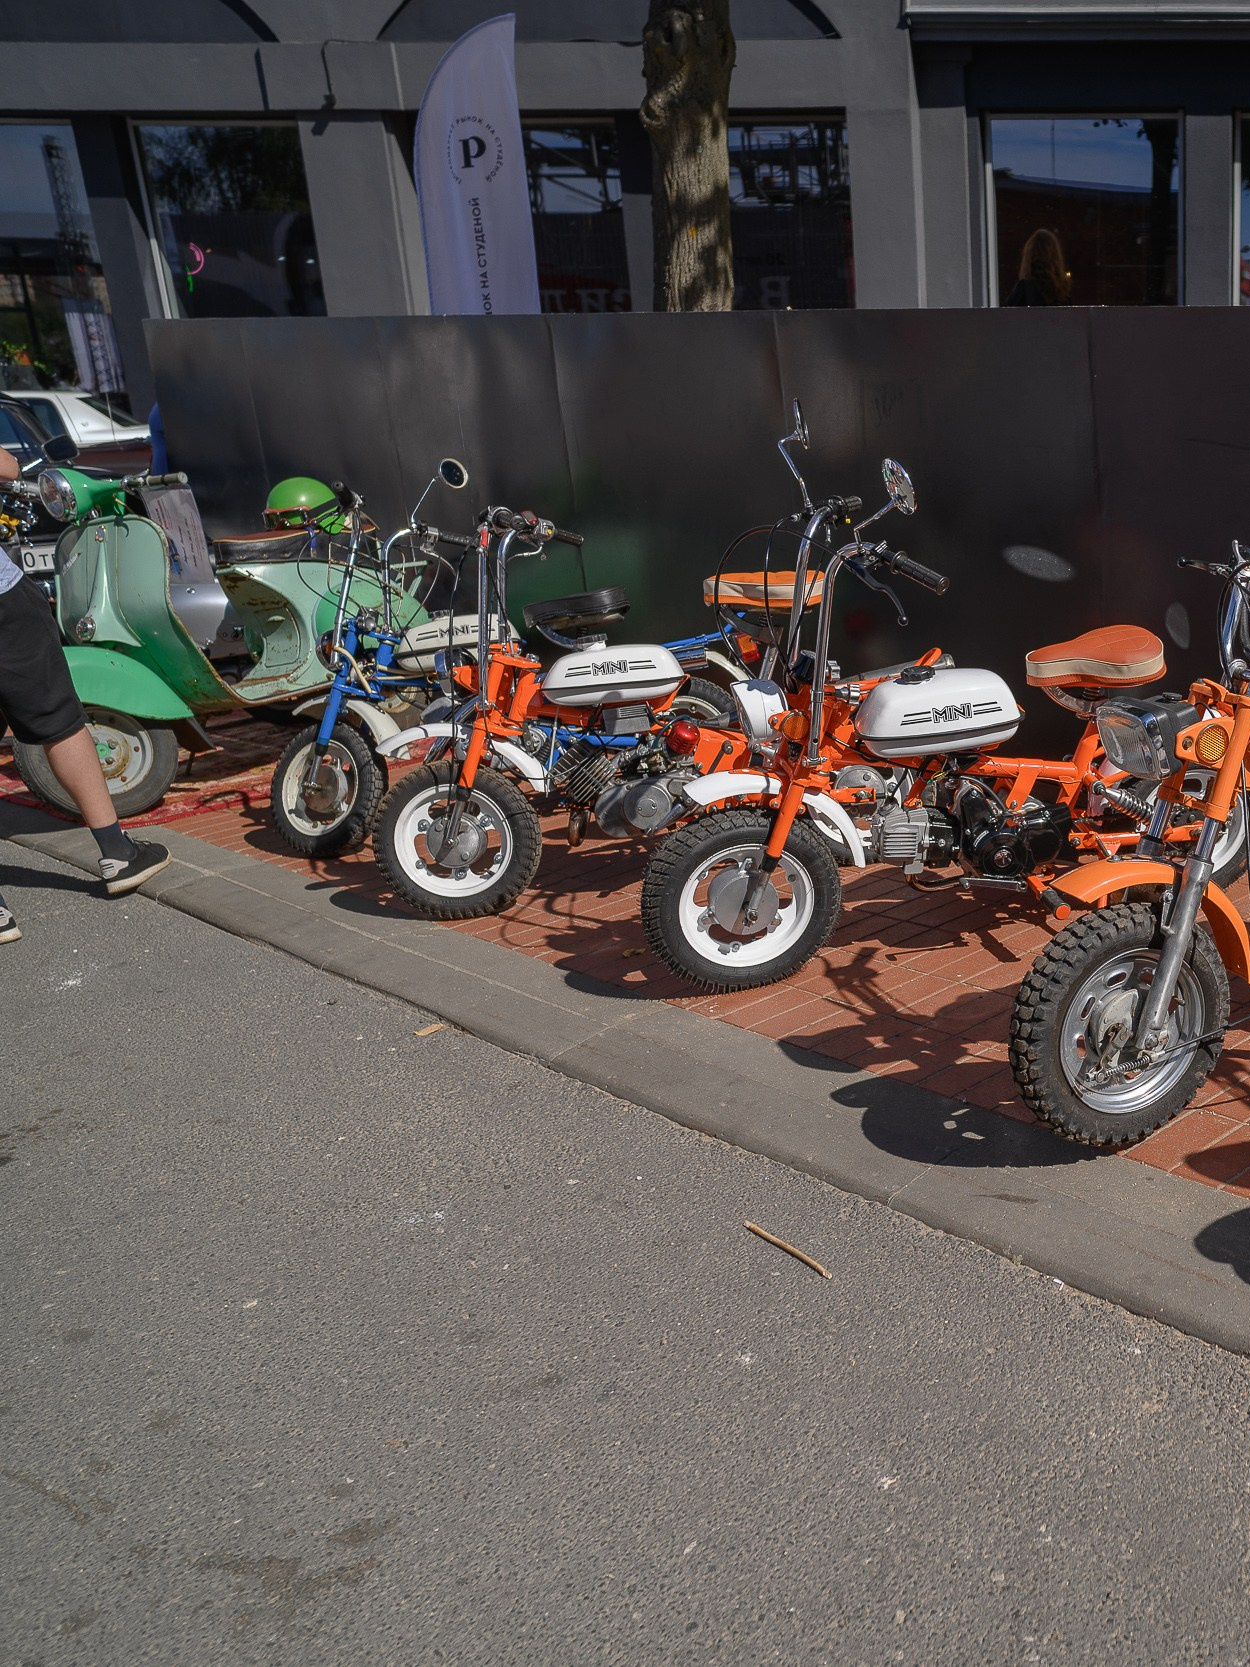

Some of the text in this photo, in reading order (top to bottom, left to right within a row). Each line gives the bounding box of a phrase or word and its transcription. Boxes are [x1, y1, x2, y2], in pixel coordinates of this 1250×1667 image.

[468, 197, 492, 315] ОК НА СТУДЕНОЙ
[439, 625, 469, 638] MNI
[592, 660, 629, 676] MINI
[932, 703, 972, 723] MINI
